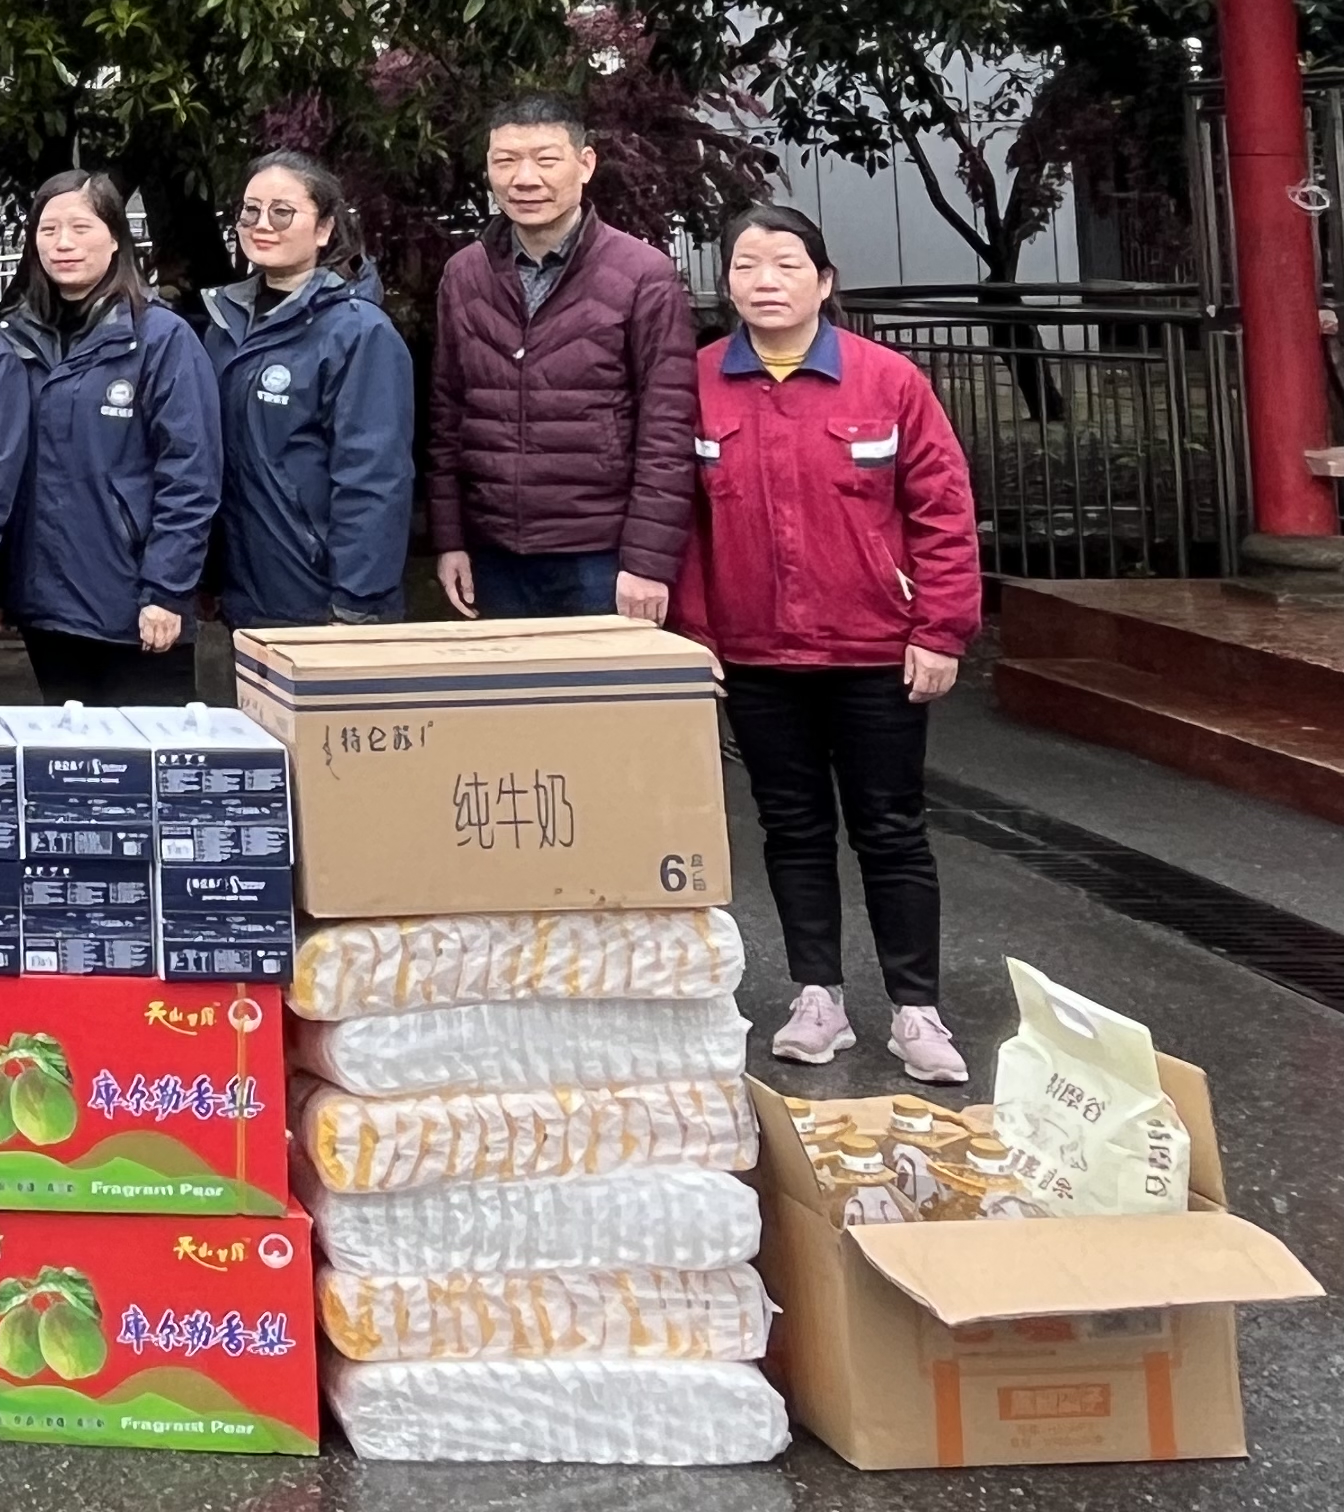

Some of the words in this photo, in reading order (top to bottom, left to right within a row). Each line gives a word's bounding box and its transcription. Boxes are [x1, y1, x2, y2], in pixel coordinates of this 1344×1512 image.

[452, 769, 575, 850] 纯牛奶
[659, 854, 688, 892] 6
[116, 1304, 296, 1356] 库尔勒香梨
